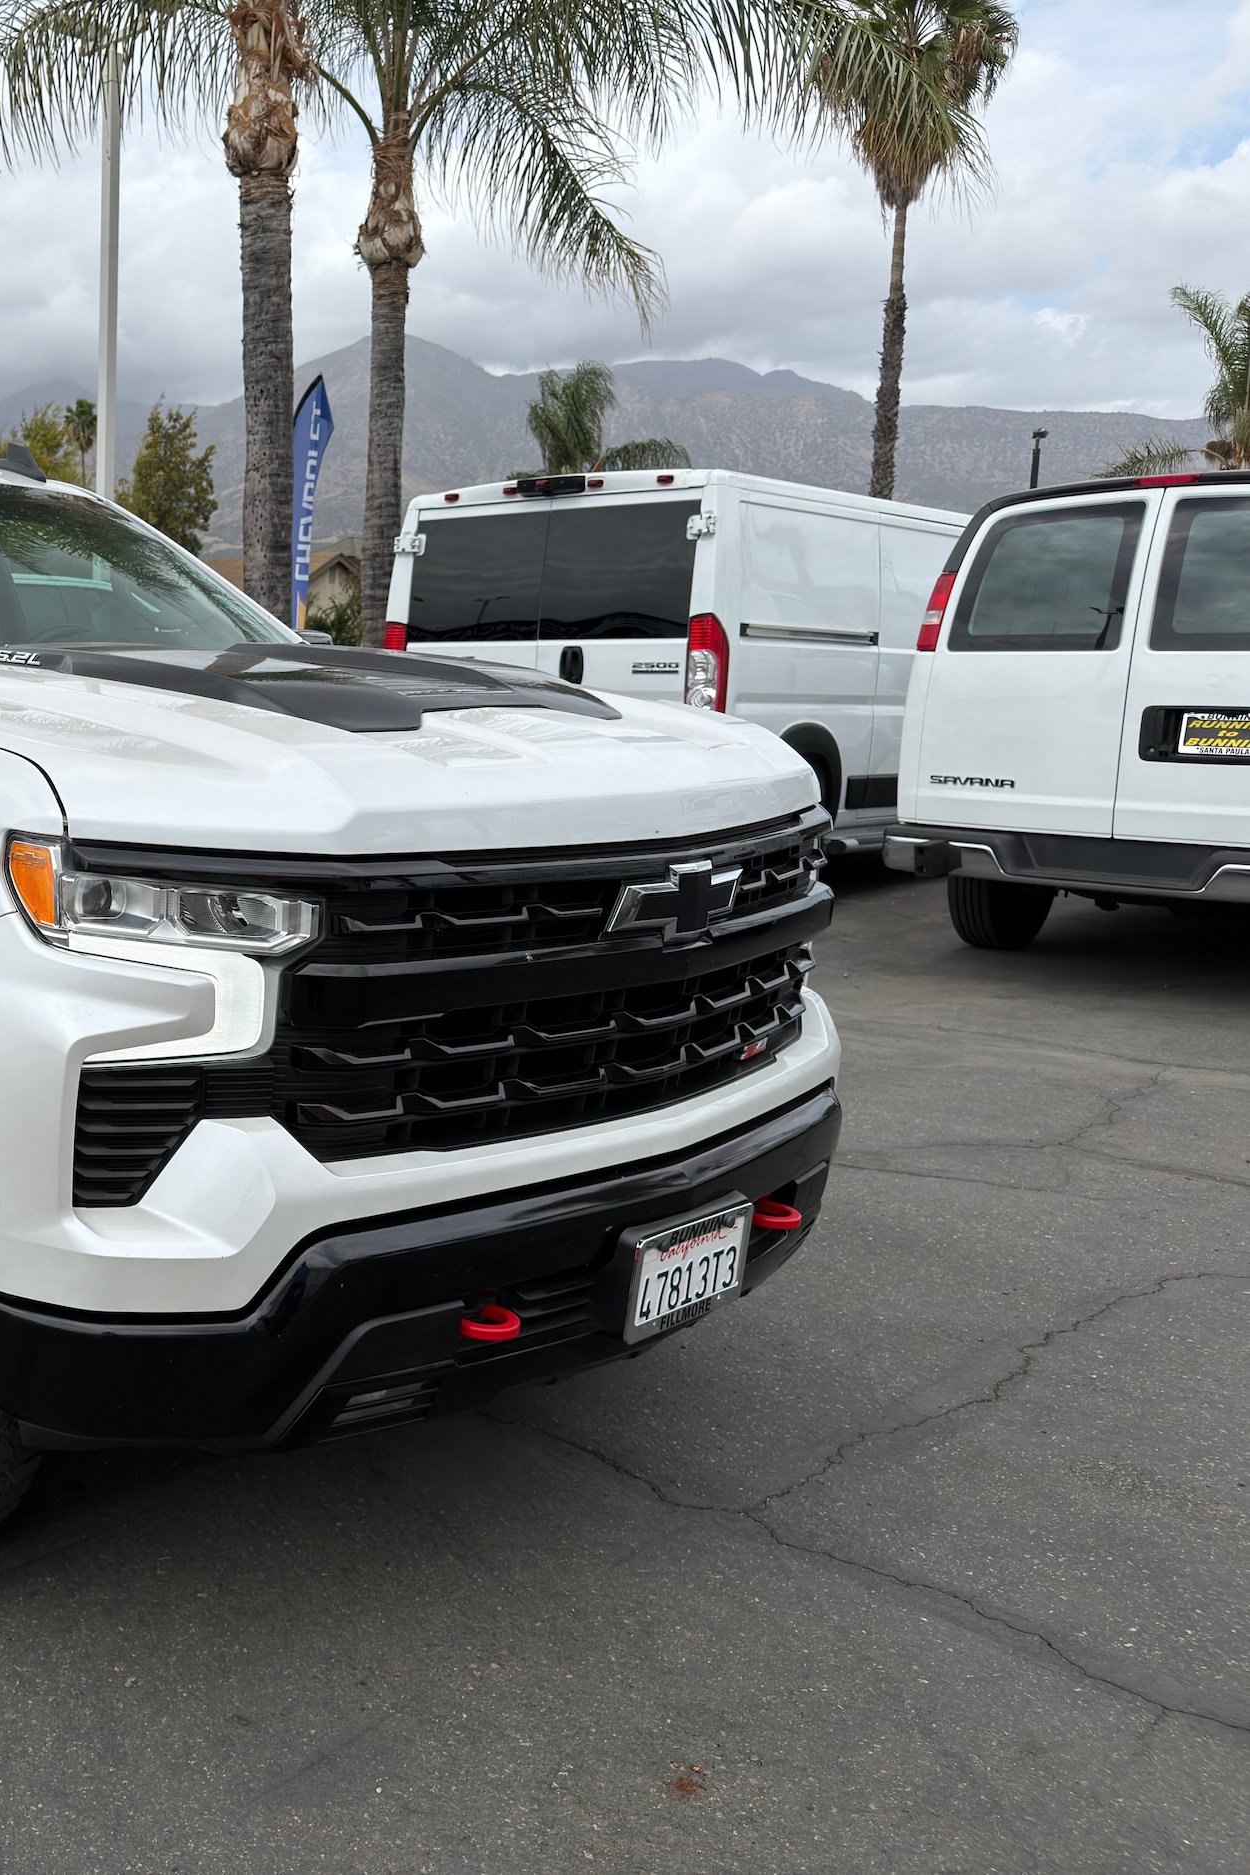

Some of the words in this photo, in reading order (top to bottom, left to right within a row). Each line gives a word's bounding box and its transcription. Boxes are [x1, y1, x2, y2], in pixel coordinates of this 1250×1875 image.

[1188, 720, 1250, 729] RUNNI
[1184, 738, 1250, 747] BUNNI
[930, 775, 1015, 789] SAVANA
[669, 1214, 725, 1246] BUNNIN
[639, 1245, 737, 1320] 47813T3
[660, 1299, 712, 1330] FILLMORE
